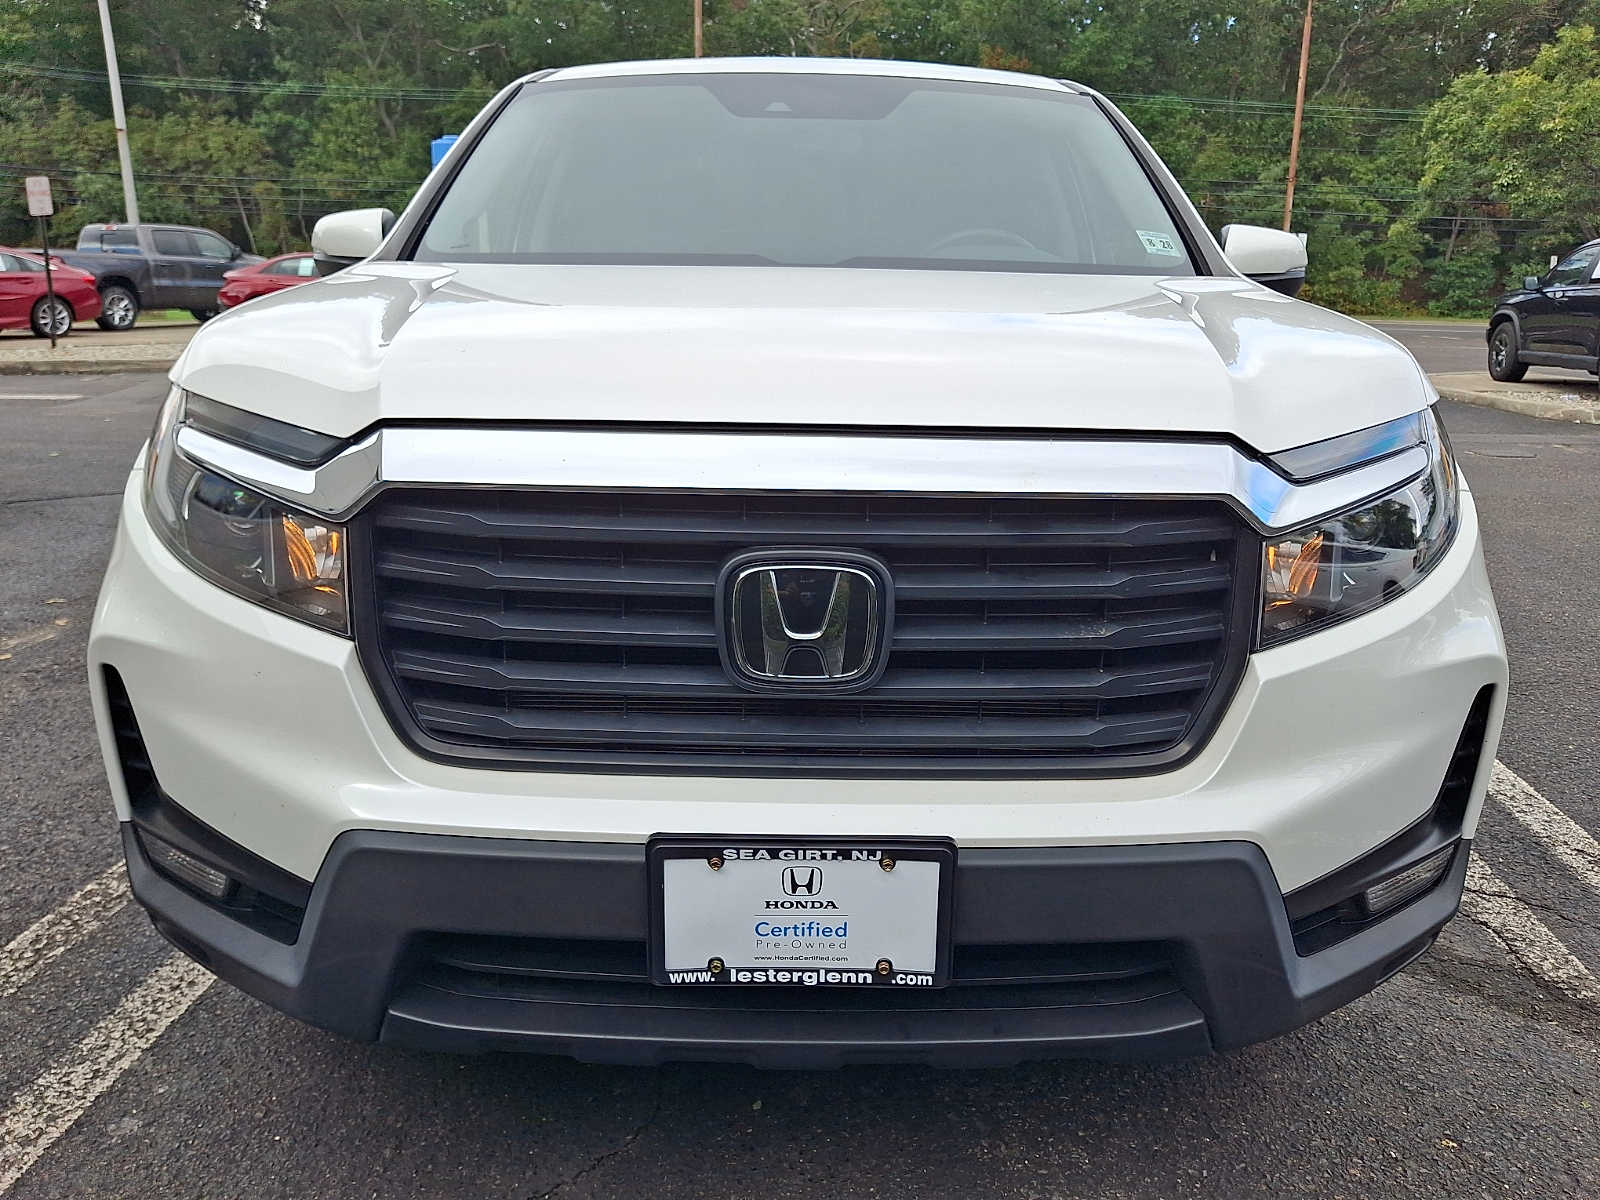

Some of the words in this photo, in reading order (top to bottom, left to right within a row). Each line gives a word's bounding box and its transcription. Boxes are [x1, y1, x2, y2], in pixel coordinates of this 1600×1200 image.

[722, 848, 772, 861] SEA
[778, 849, 843, 861] GIRT,
[851, 850, 883, 862] NJ
[764, 900, 839, 910] HONDA
[754, 921, 848, 938] Certified
[756, 939, 848, 950] Pre-Owned
[730, 968, 873, 986] lesterglenn
